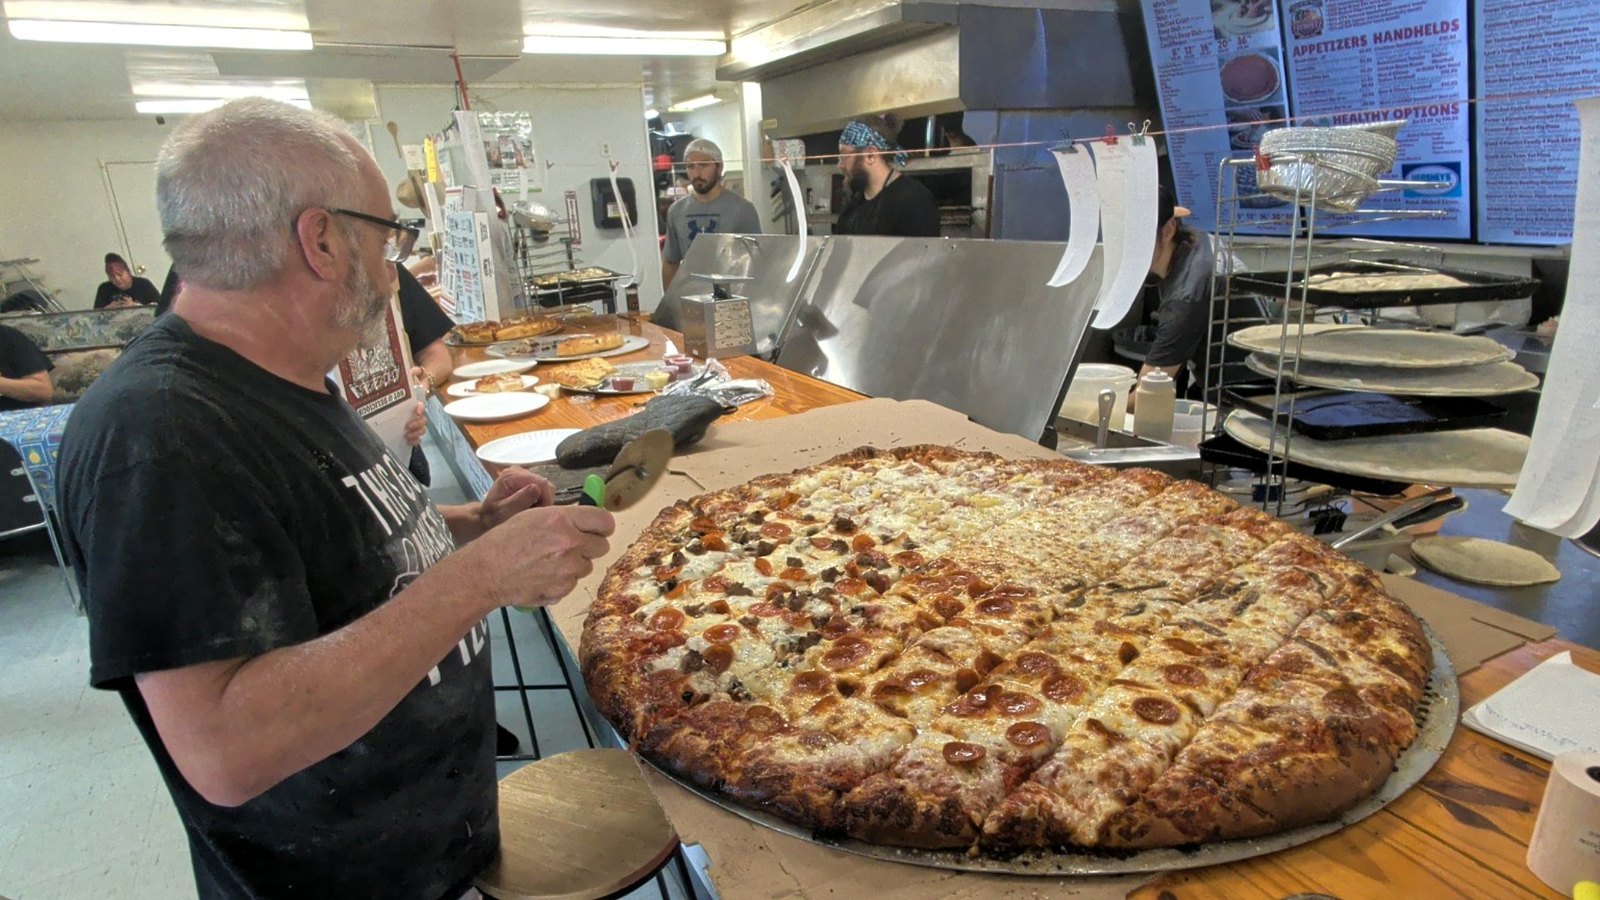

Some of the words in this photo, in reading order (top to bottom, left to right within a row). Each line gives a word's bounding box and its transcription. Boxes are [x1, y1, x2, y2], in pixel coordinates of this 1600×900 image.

[1293, 34, 1367, 58] APPETIZERS
[1373, 18, 1460, 44] HANDHELDS
[1333, 108, 1389, 125] HEALTHY
[1393, 103, 1460, 121] OPTIONS
[393, 390, 405, 400] HOT
